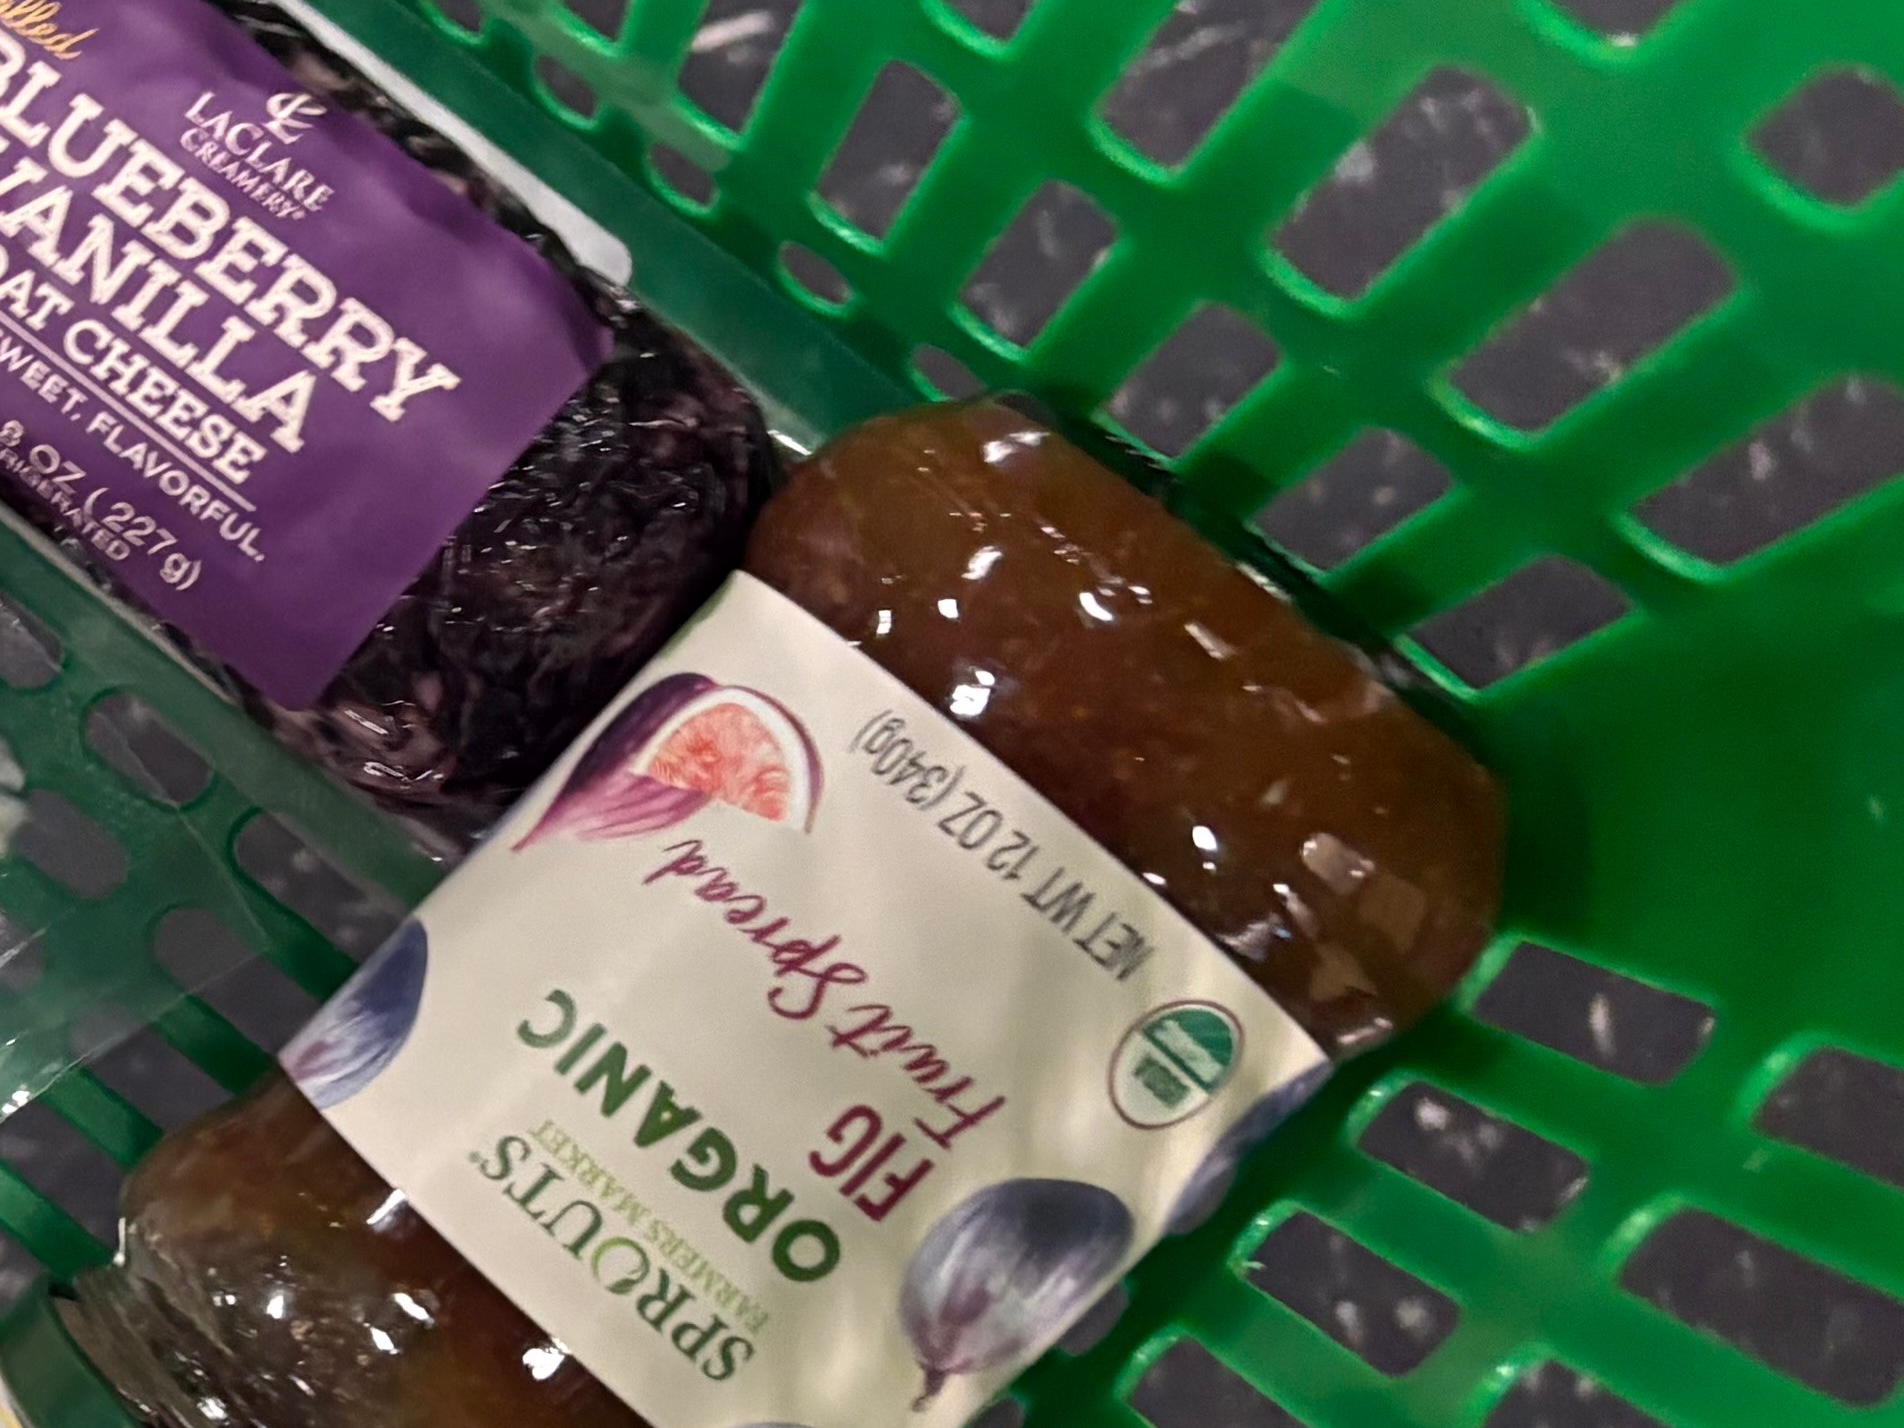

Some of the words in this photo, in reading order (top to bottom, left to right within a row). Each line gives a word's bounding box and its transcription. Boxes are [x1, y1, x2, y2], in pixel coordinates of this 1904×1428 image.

[64, 319, 266, 483] CHEESE
[20, 444, 86, 493] OZ
[86, 411, 264, 561] FLAVORFUL.
[855, 711, 964, 811] (340g)
[937, 792, 1003, 850] OZ
[987, 831, 1039, 880] 12
[644, 840, 868, 1034] Spread
[1021, 868, 1095, 934] WT
[1076, 913, 1153, 981] NET
[830, 1005, 1005, 1150] Fruit
[519, 990, 841, 1283] ORGANIC
[528, 1120, 649, 1226] MARKET
[810, 1106, 934, 1222] FIG
[640, 1220, 778, 1338] FARMERS
